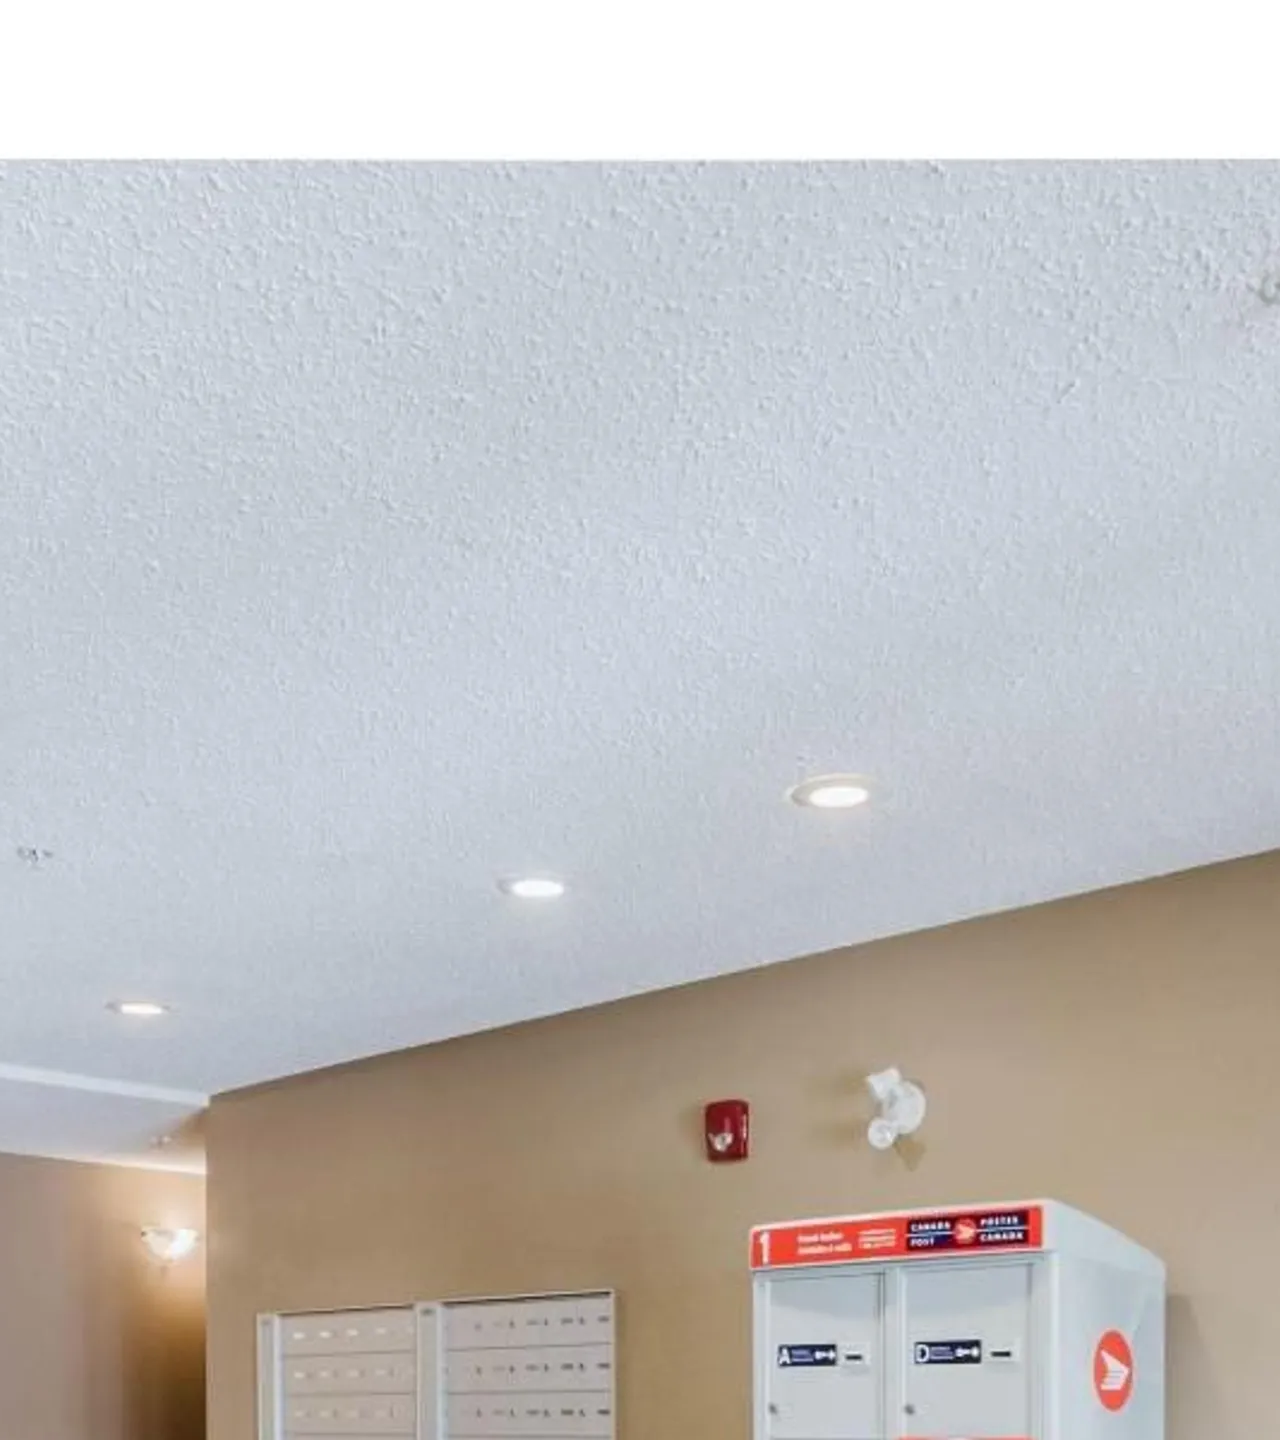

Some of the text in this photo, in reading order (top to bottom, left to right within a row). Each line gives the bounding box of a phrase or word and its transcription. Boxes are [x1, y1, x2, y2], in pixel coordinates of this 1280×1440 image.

[758, 1231, 770, 1264] 1
[778, 1347, 792, 1365] A
[916, 1344, 930, 1363] D
